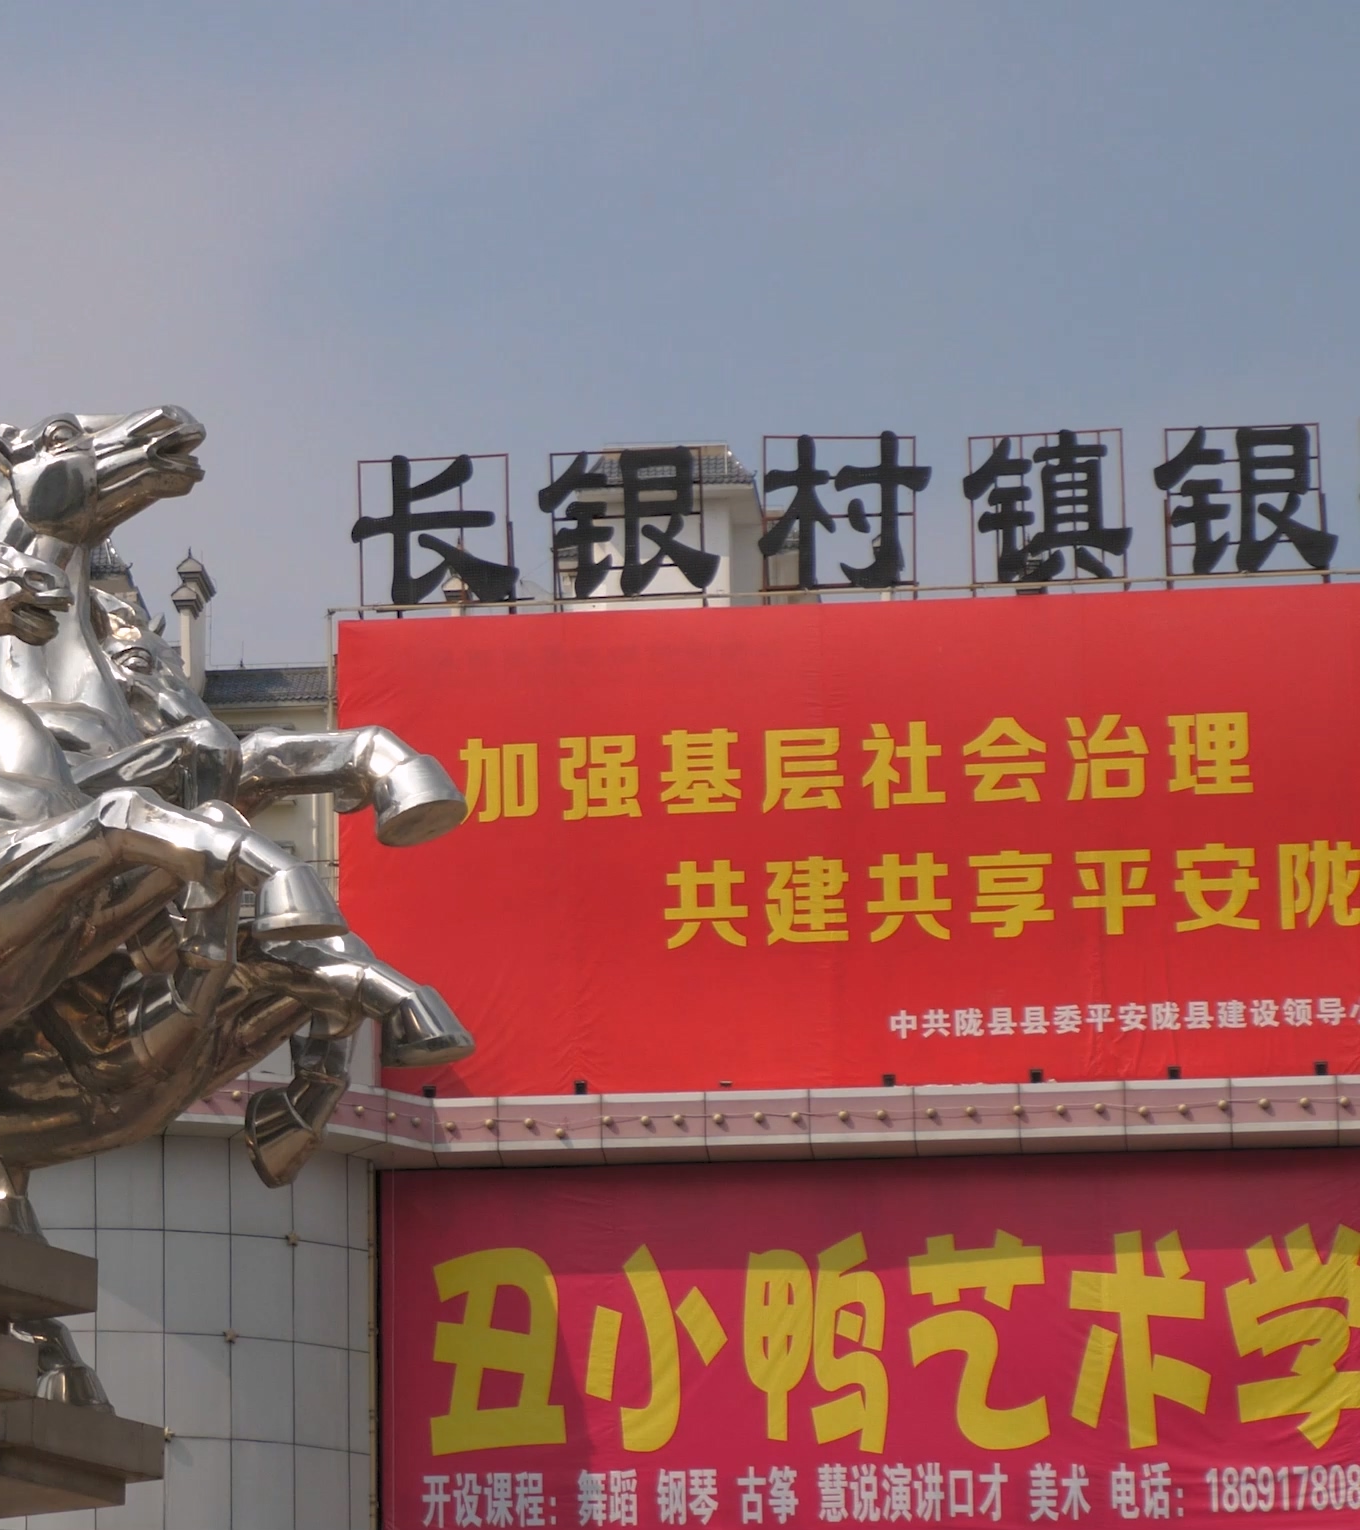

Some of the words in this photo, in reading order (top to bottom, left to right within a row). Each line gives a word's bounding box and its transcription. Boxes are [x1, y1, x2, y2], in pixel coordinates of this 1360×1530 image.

[351, 423, 1339, 606] 长银村镇银
[459, 711, 1255, 824] 加强基层社会治理
[663, 840, 1360, 949] 共建共享平安陇
[430, 1222, 1360, 1456] 丑小鸭艺术学
[576, 1469, 639, 1527] 舞蹈
[657, 1468, 719, 1525] 钢琴
[737, 1465, 799, 1524] 古筝
[817, 1462, 1009, 1523] 慧说演讲口才
[1029, 1463, 1091, 1522] 美术
